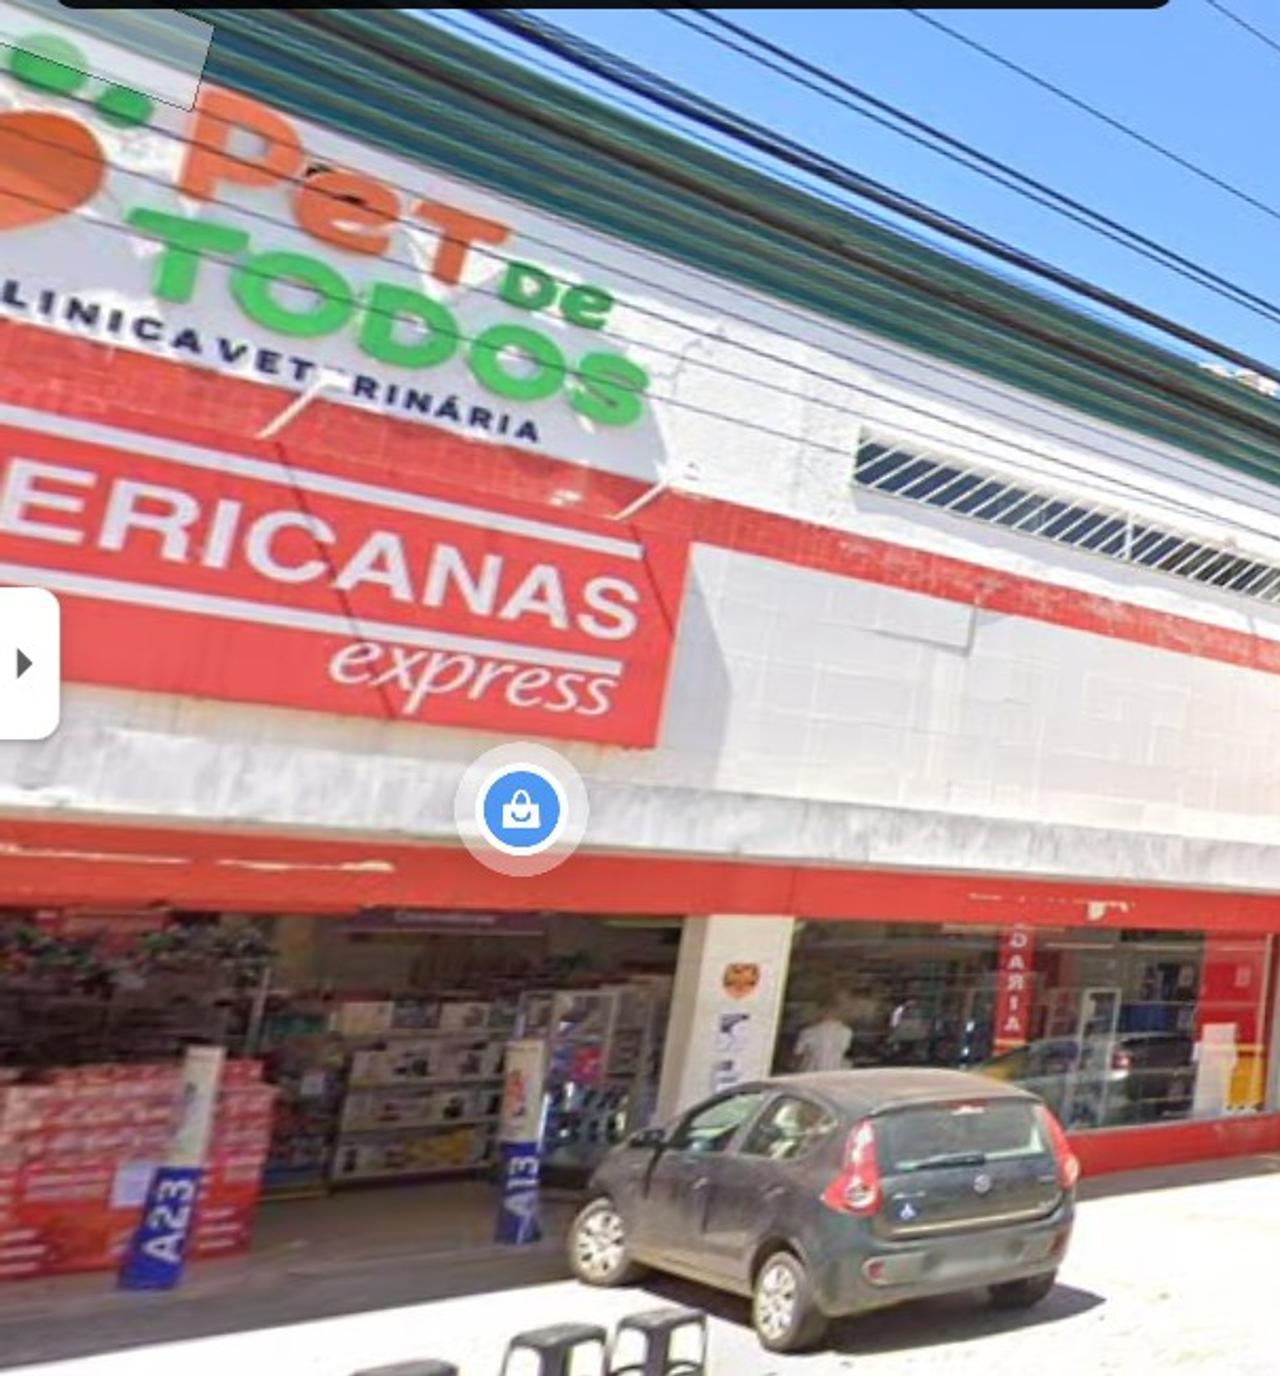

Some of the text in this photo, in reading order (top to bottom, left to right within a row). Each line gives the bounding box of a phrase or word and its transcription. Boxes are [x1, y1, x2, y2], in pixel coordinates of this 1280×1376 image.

[127, 207, 650, 427] TODOS
[217, 337, 540, 443] VETRINÁRIA
[0, 456, 640, 641] ERICANAS
[329, 641, 621, 715] express
